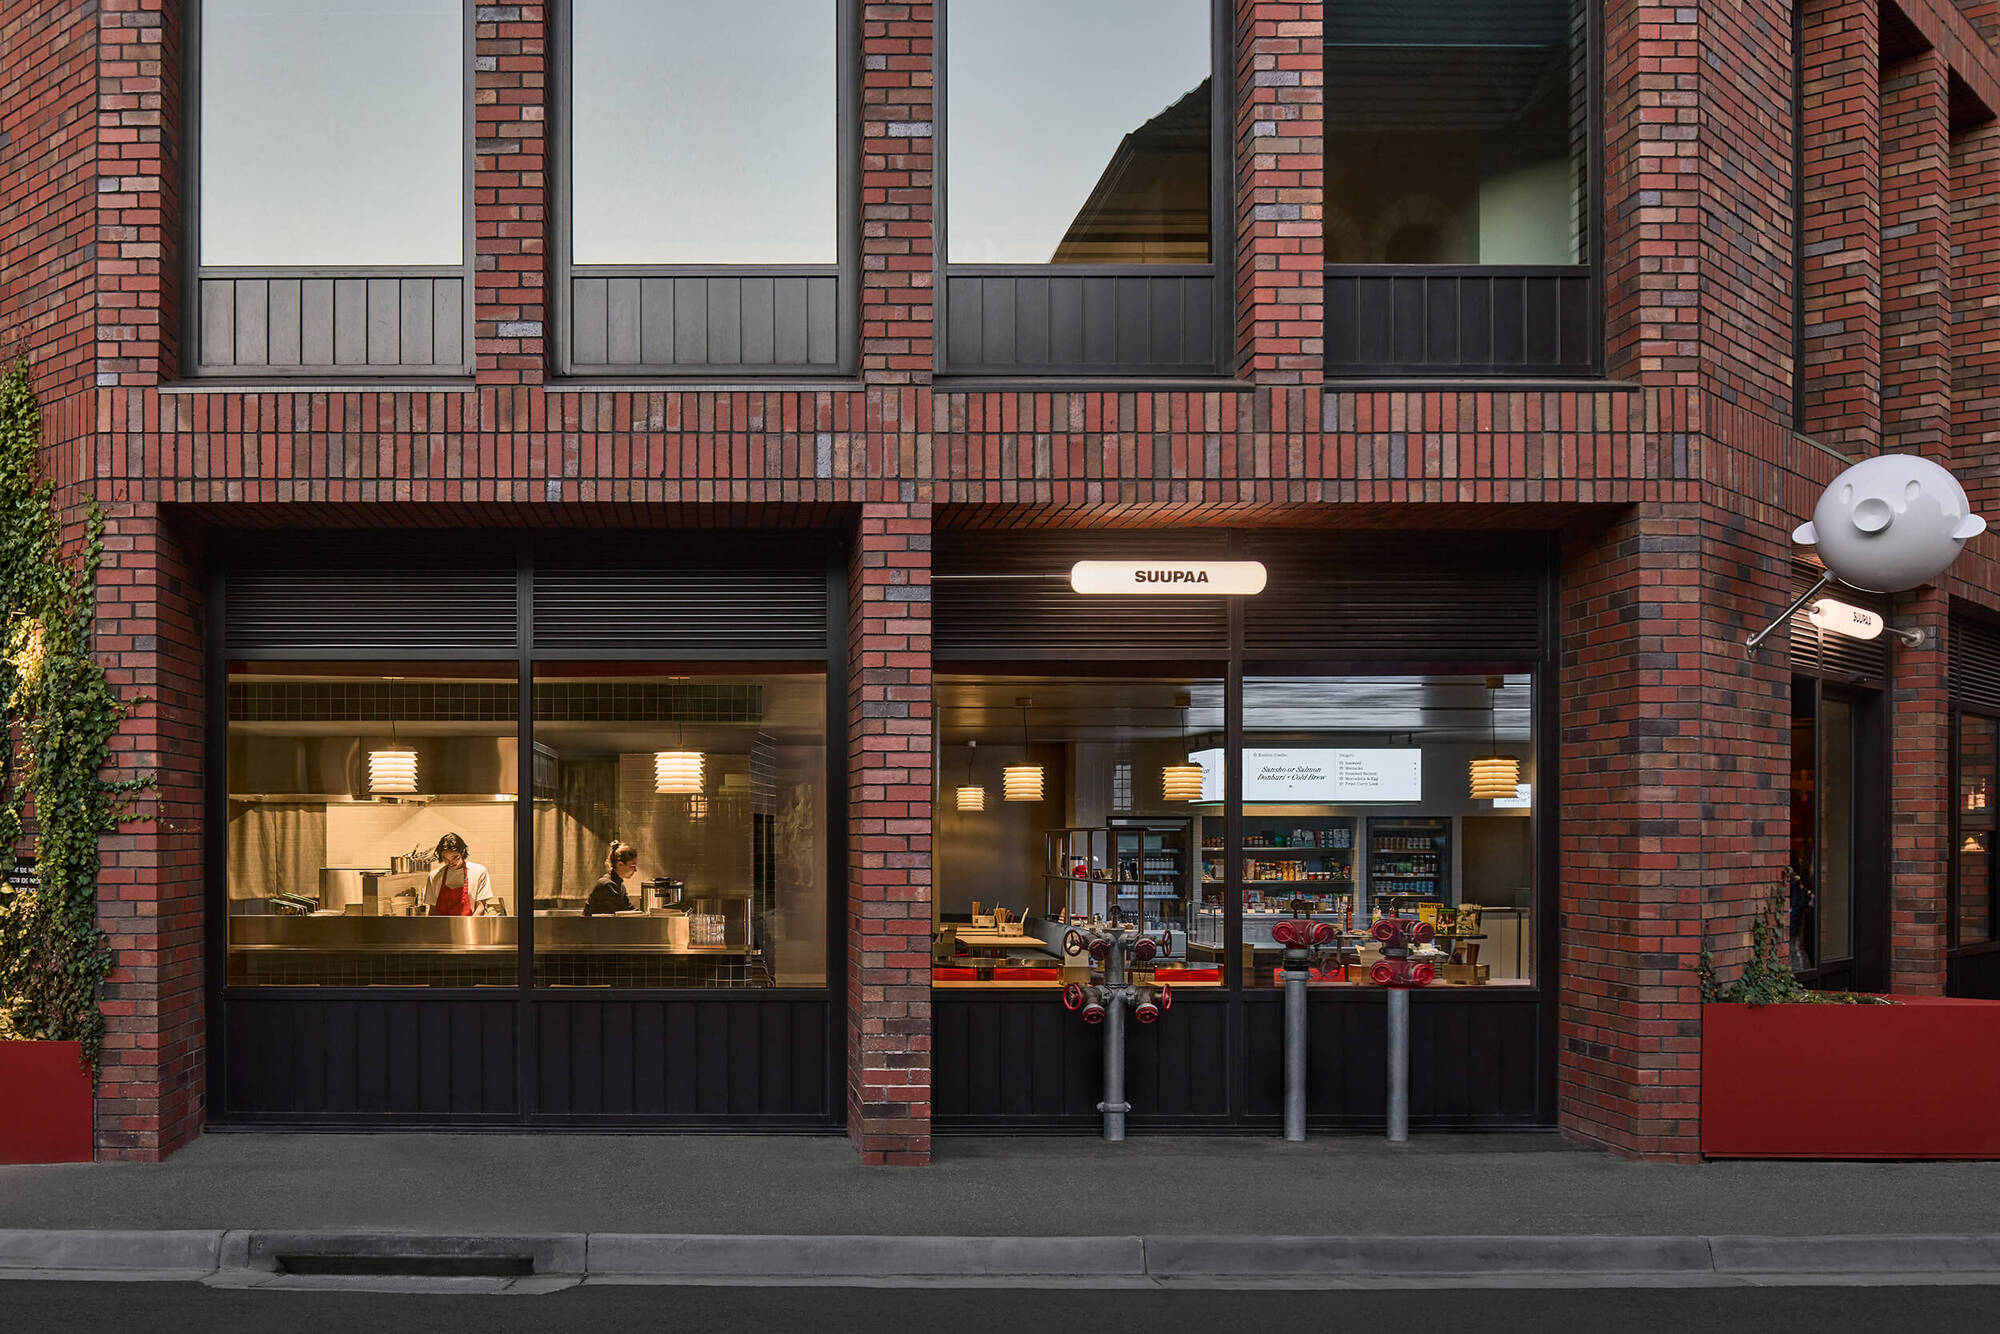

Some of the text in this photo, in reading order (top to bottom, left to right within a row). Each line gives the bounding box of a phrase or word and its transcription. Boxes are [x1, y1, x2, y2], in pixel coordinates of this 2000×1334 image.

[1134, 570, 1209, 583] SUUPAA
[1291, 773, 1308, 781] Cold
[1307, 773, 1327, 781] Brew
